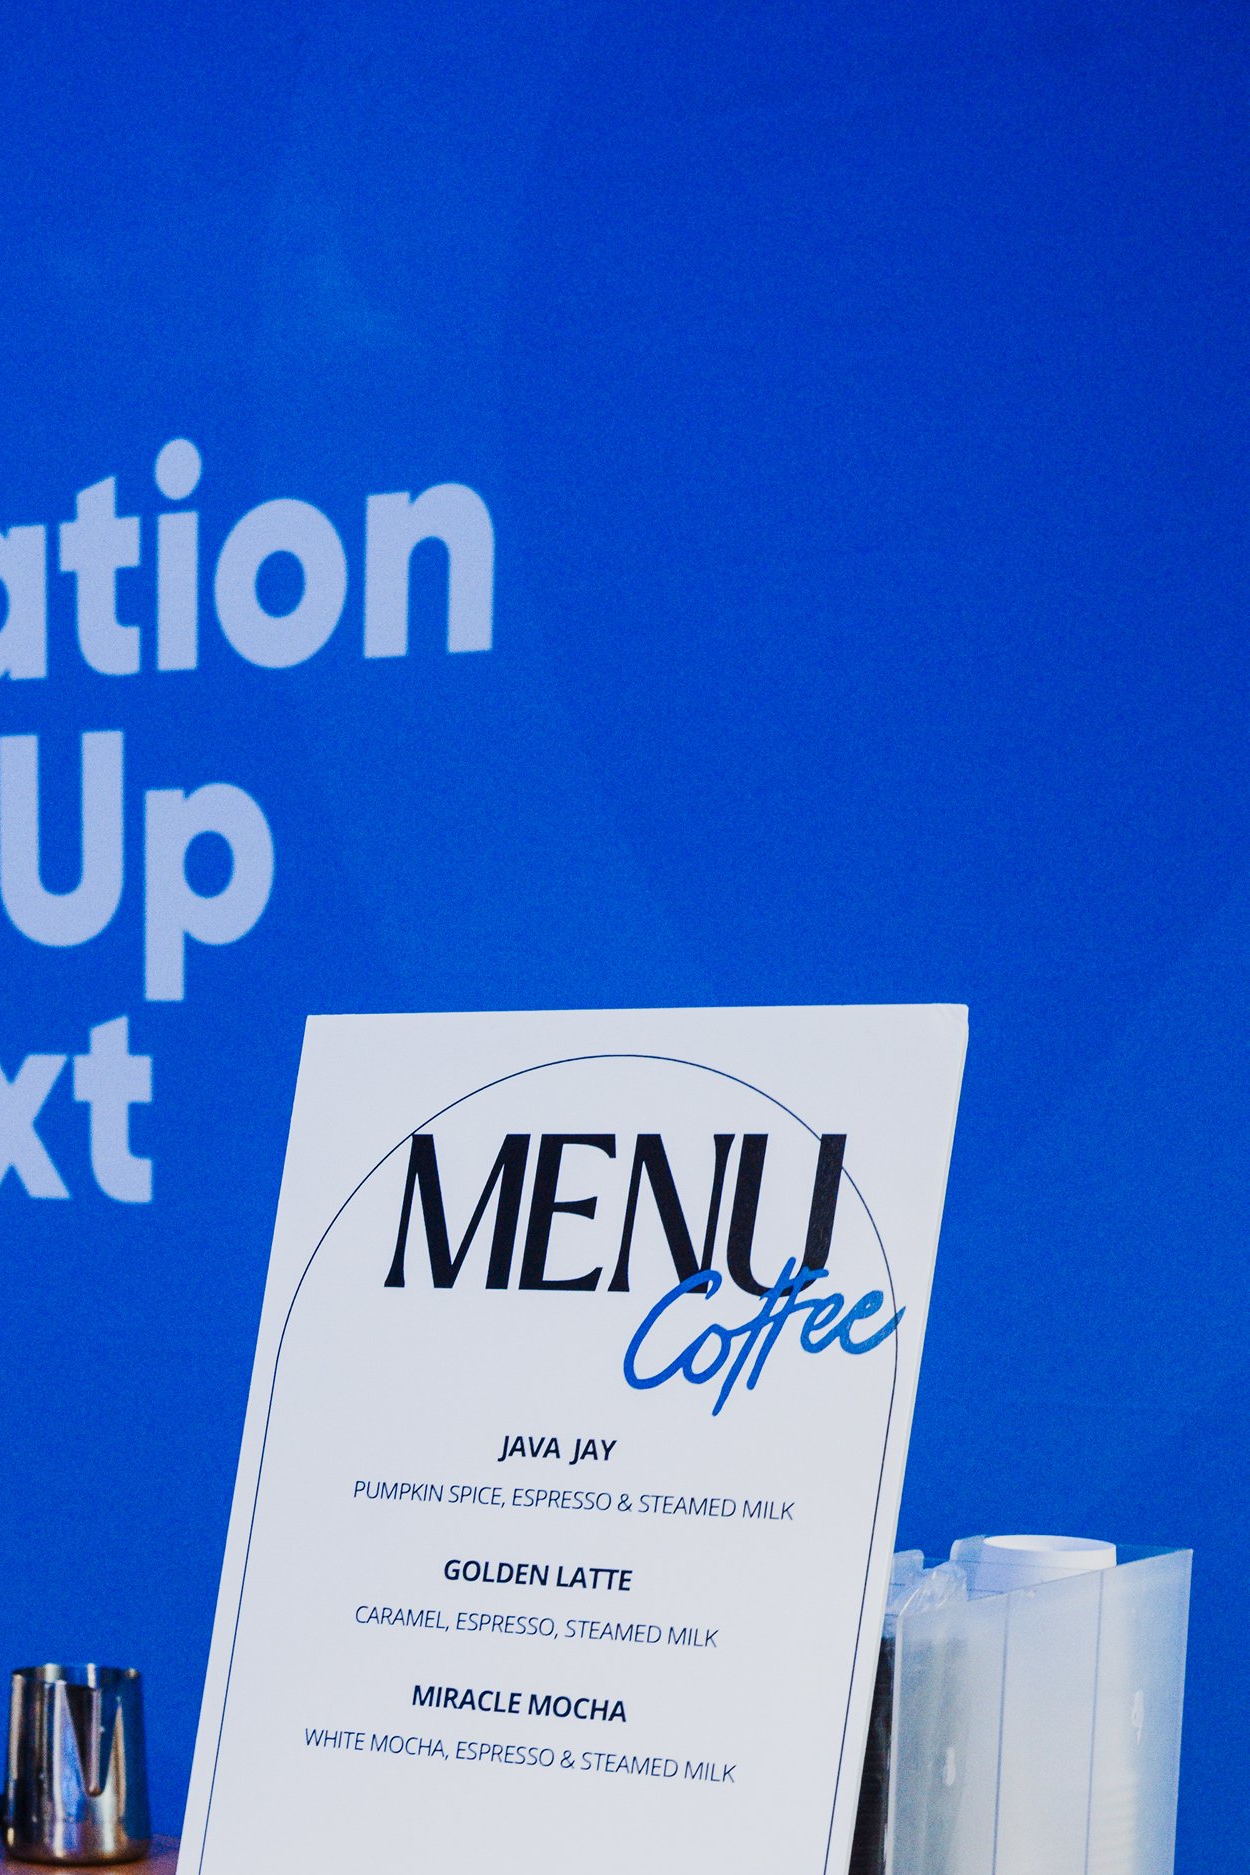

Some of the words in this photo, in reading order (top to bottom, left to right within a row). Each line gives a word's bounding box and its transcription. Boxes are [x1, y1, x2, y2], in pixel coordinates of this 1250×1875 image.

[384, 1133, 847, 1297] MENU
[623, 1257, 906, 1416] Coffee
[497, 1435, 561, 1462] JAVA
[569, 1438, 618, 1465] JAY
[353, 1480, 444, 1503] PUMPKIN
[448, 1485, 506, 1508] SPICE,
[512, 1488, 612, 1511] ESPRESSO
[617, 1493, 633, 1512] &
[638, 1494, 737, 1518] STEAMED
[742, 1499, 796, 1521] MILK
[443, 1558, 550, 1586] GOLDEN
[556, 1565, 634, 1591] LATTE
[355, 1605, 449, 1632] CARAMEL,
[455, 1612, 558, 1639] ESPRESSO,
[564, 1619, 662, 1644] STEAMED
[667, 1626, 719, 1648] MILK
[411, 1684, 522, 1714] MIRACLE
[527, 1693, 627, 1722] MOCHA
[305, 1727, 366, 1750] WHITE
[370, 1733, 450, 1761] MOCHA,
[455, 1740, 554, 1768] ESPRESSO
[560, 1749, 575, 1769] &
[580, 1751, 679, 1778] STEAMED
[683, 1760, 737, 1783] MILK
